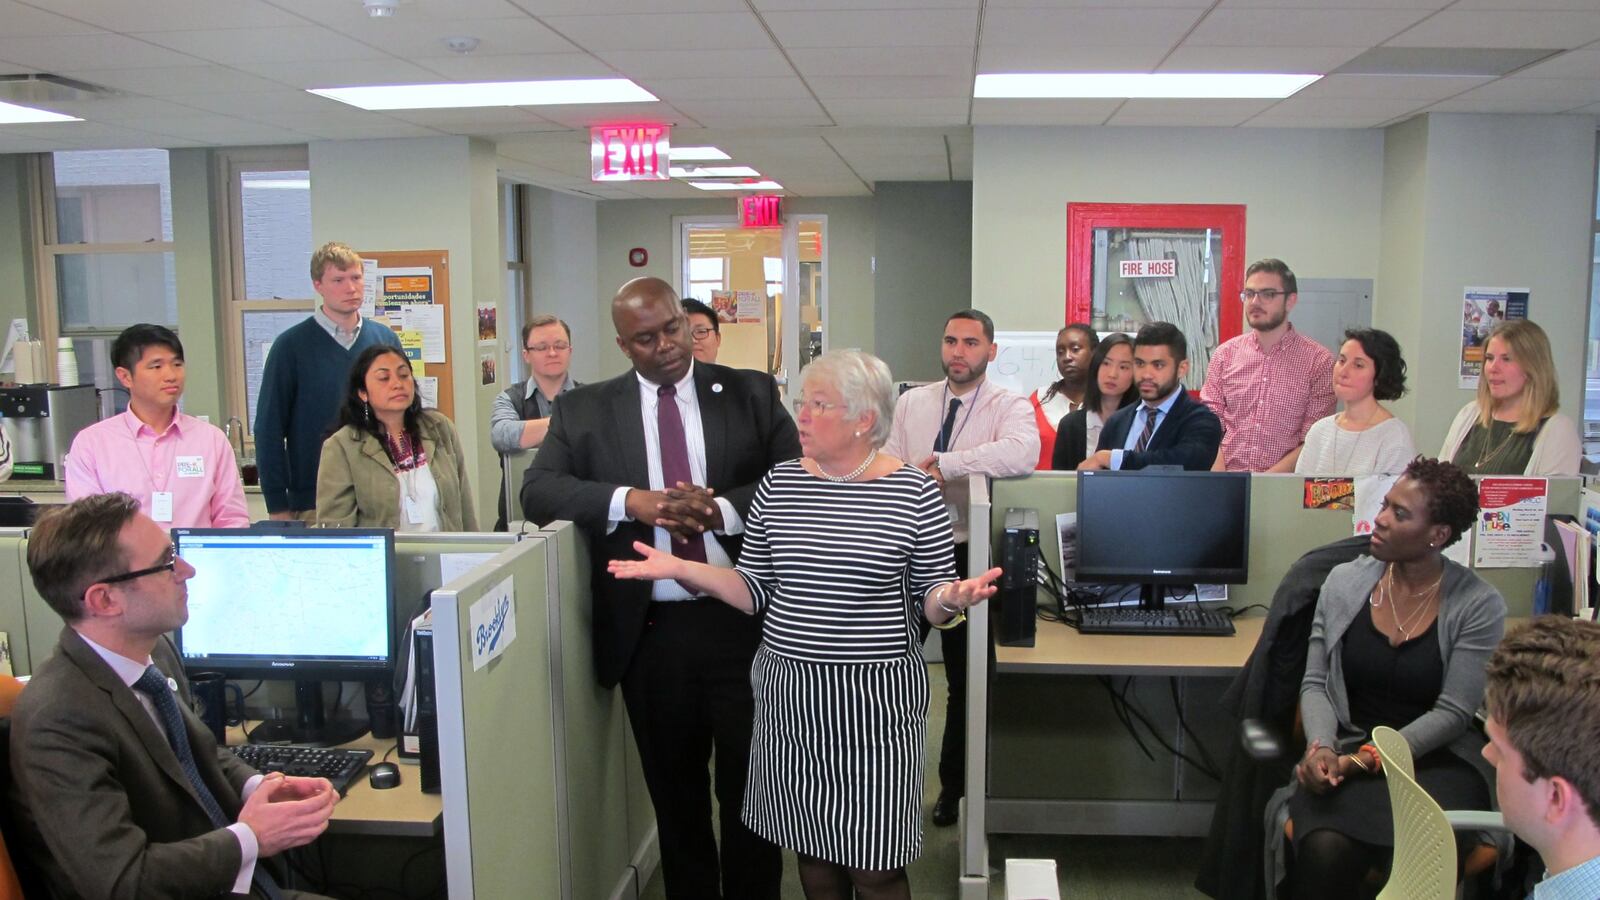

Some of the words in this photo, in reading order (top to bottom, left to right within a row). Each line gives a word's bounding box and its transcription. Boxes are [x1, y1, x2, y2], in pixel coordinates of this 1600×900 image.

[603, 128, 661, 175] EXIT
[743, 197, 778, 225] EXIT
[1122, 262, 1142, 275] FIRE
[1148, 261, 1173, 274] HOSE
